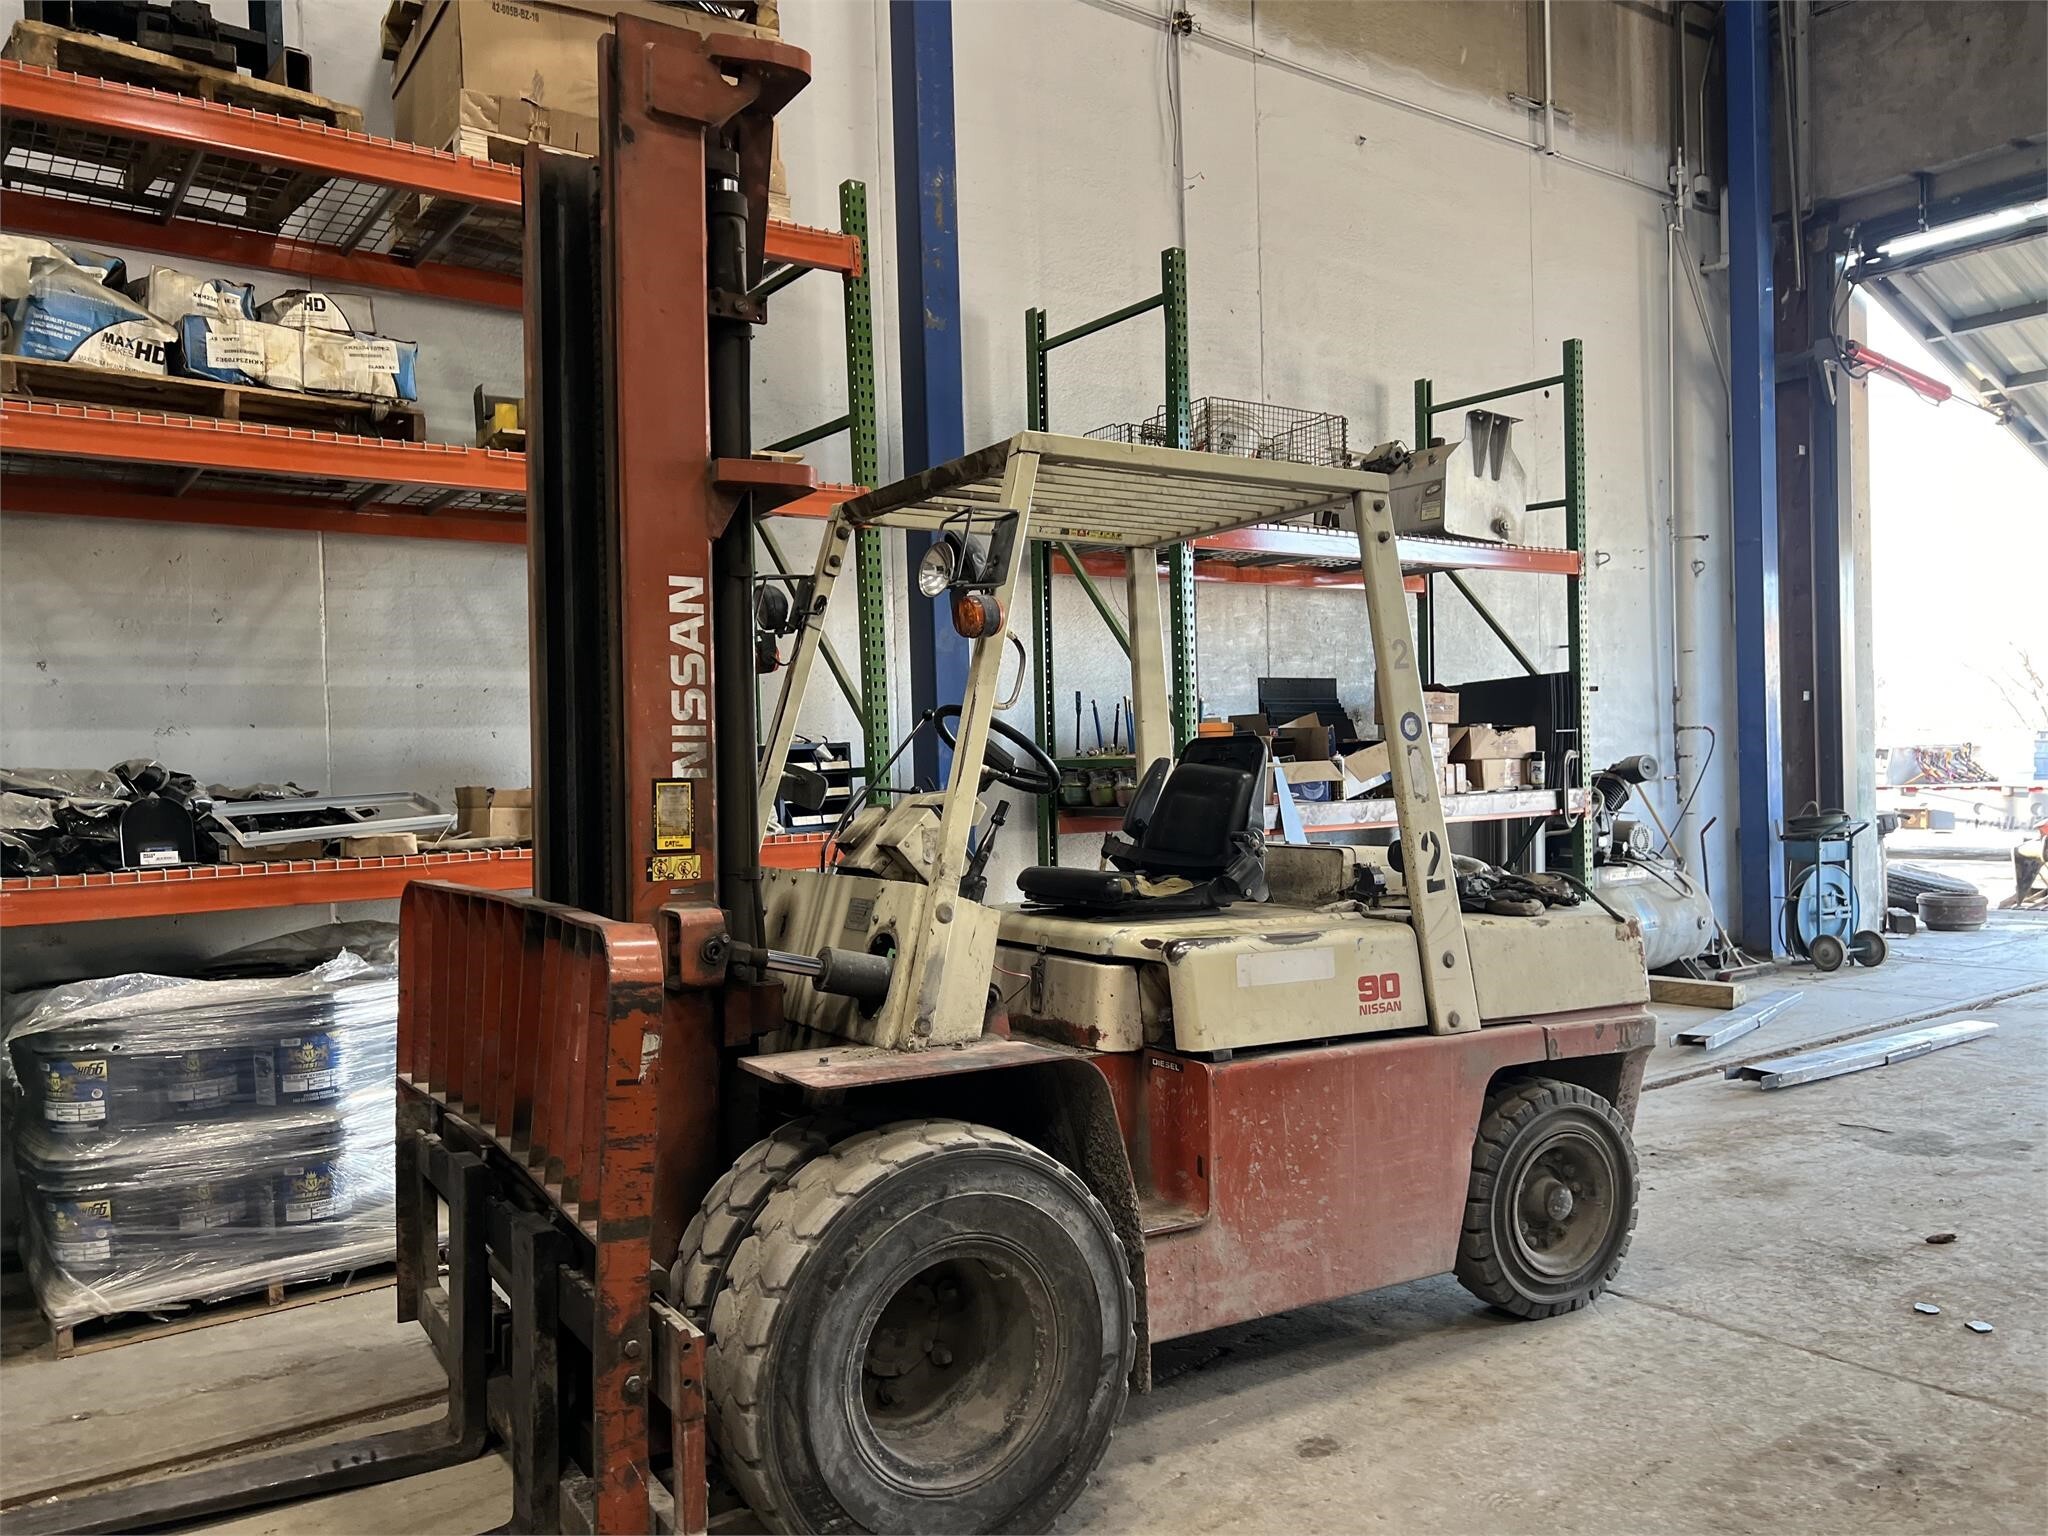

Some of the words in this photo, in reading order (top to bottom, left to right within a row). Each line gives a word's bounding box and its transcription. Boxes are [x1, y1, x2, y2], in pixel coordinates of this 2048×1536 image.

[304, 296, 326, 312] HD
[100, 341, 135, 358] BRAKES
[102, 332, 136, 350] MAX
[134, 340, 166, 365] HD
[668, 575, 707, 778] NISSAN
[1421, 831, 1446, 893] 2
[1358, 973, 1401, 1002] 90
[1359, 1001, 1402, 1016] NISSAN
[1152, 1058, 1180, 1072] DIESEL
